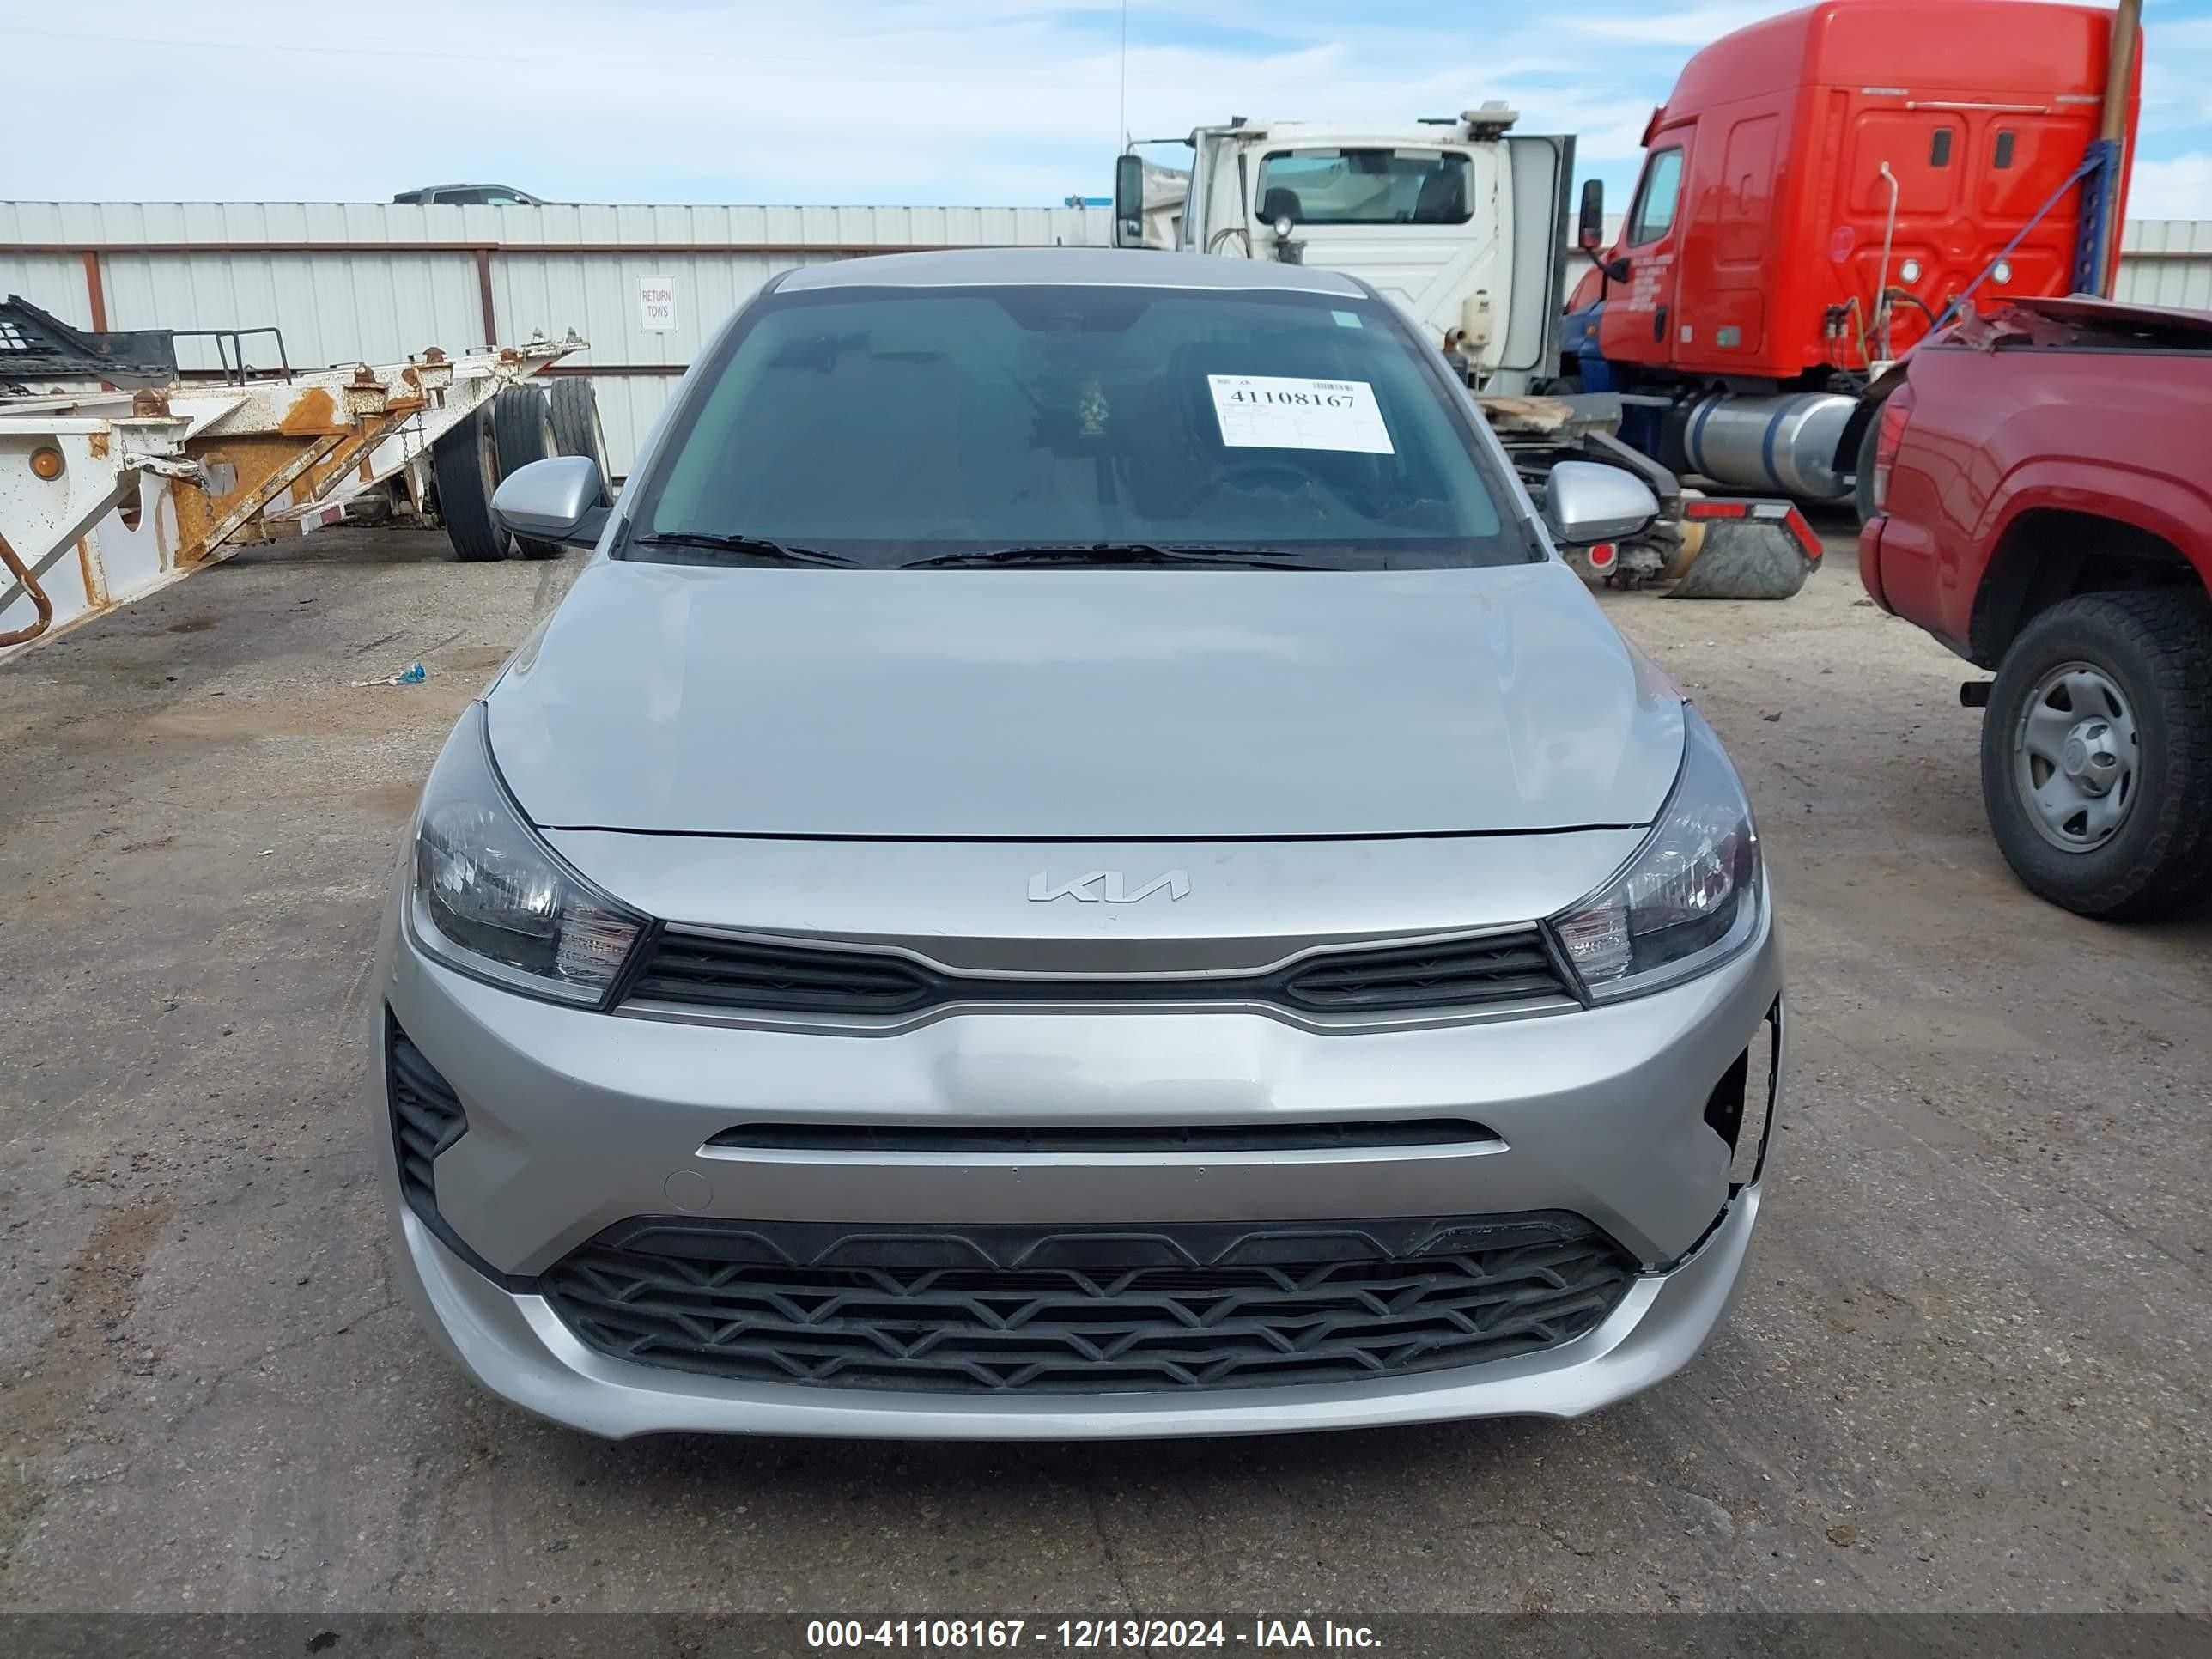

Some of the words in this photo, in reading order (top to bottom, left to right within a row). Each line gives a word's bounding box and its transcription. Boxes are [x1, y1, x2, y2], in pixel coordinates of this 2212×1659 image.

[642, 289, 672, 302] RETURN
[647, 305, 668, 318] TOWS
[1230, 390, 1354, 409] 41108167
[1027, 870, 1191, 903] KIA
